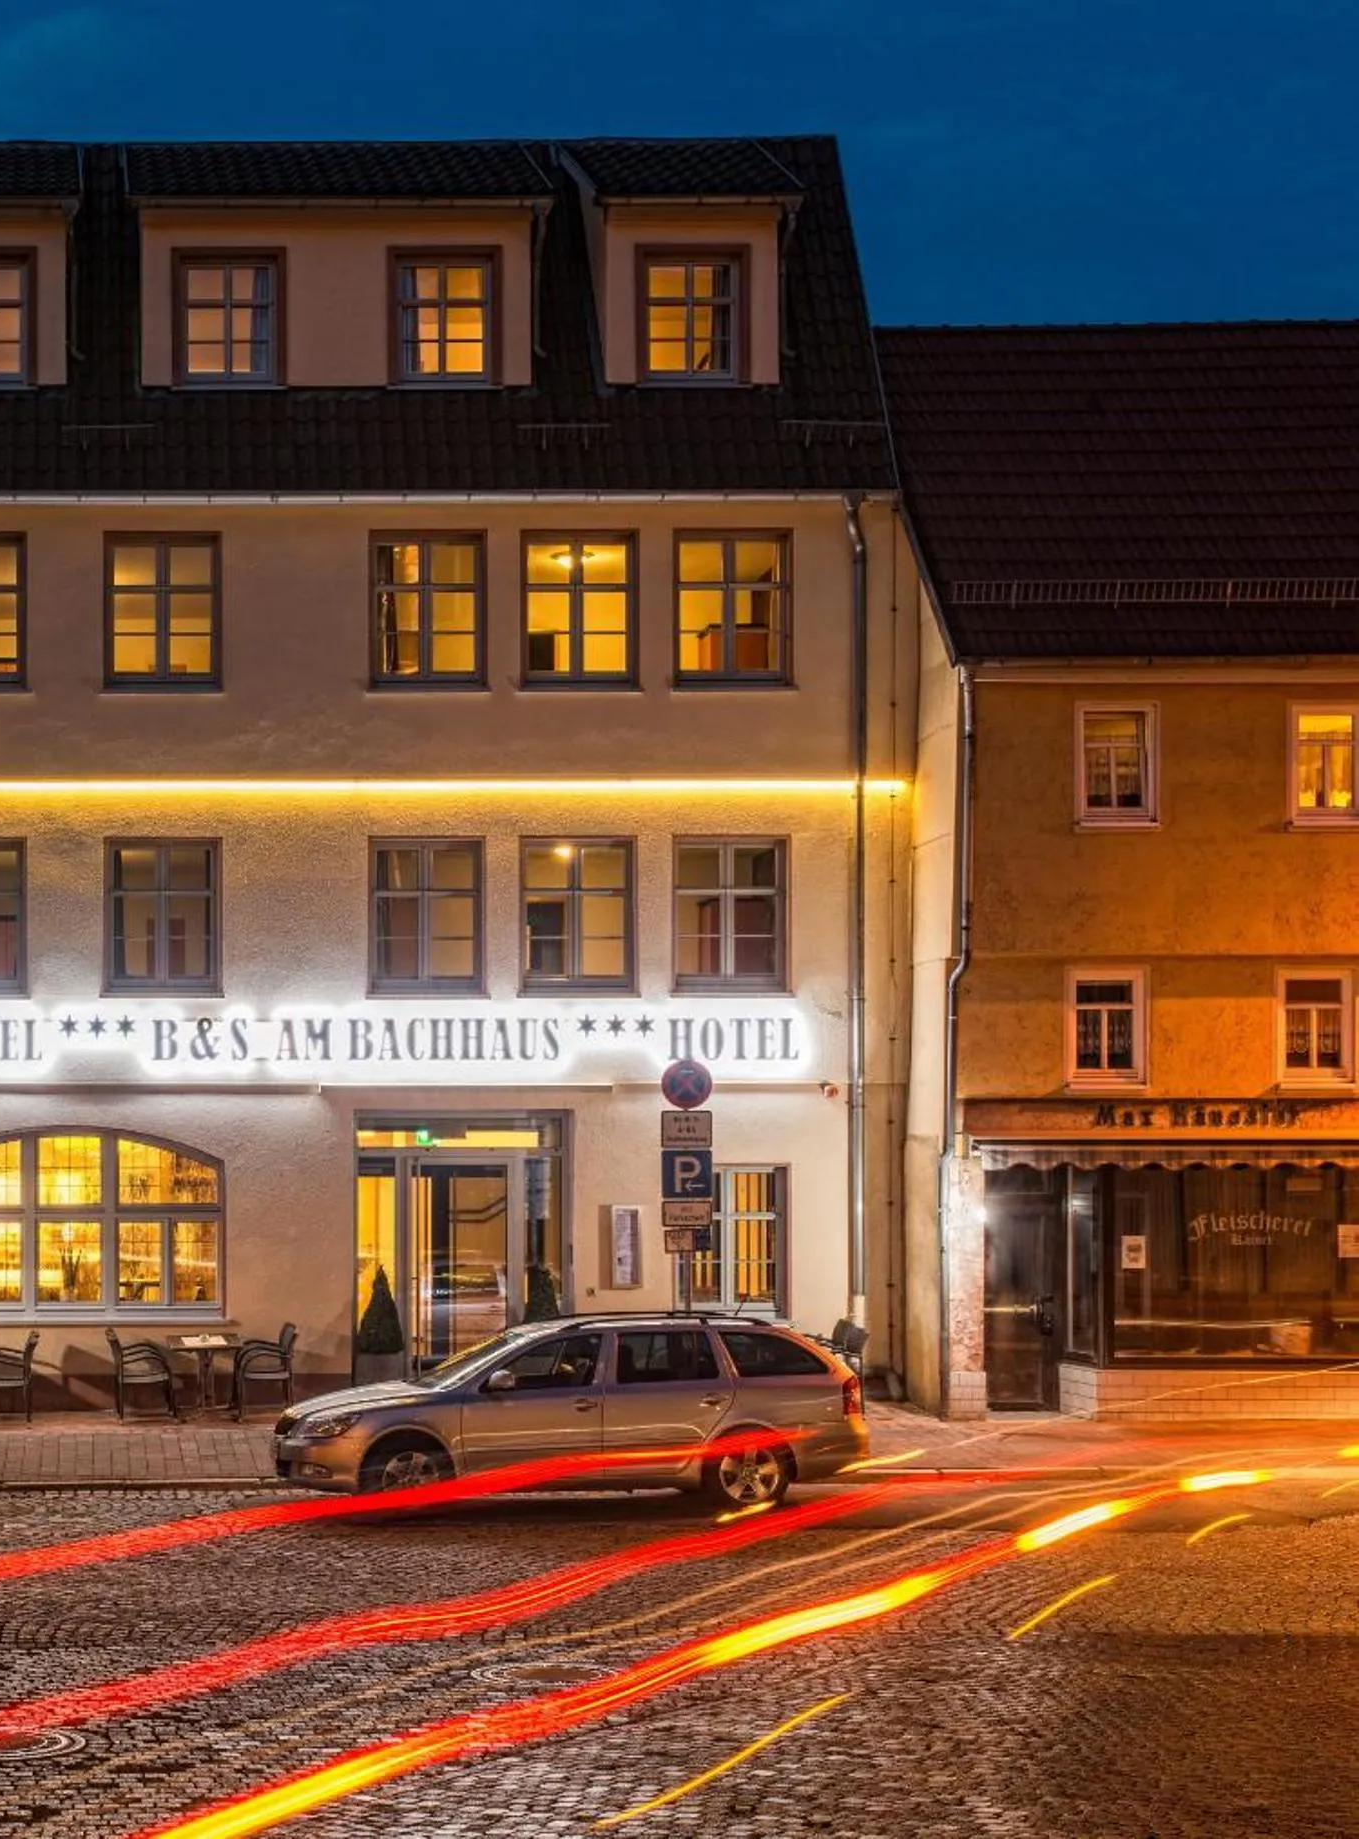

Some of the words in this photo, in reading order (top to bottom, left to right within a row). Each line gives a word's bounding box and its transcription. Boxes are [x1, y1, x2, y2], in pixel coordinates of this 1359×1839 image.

[276, 1018, 333, 1061] AM
[348, 1018, 560, 1061] BACHHAUS
[668, 1018, 800, 1061] HOTEL
[673, 1155, 702, 1193] P
[1187, 1210, 1313, 1242] Fleischerei
